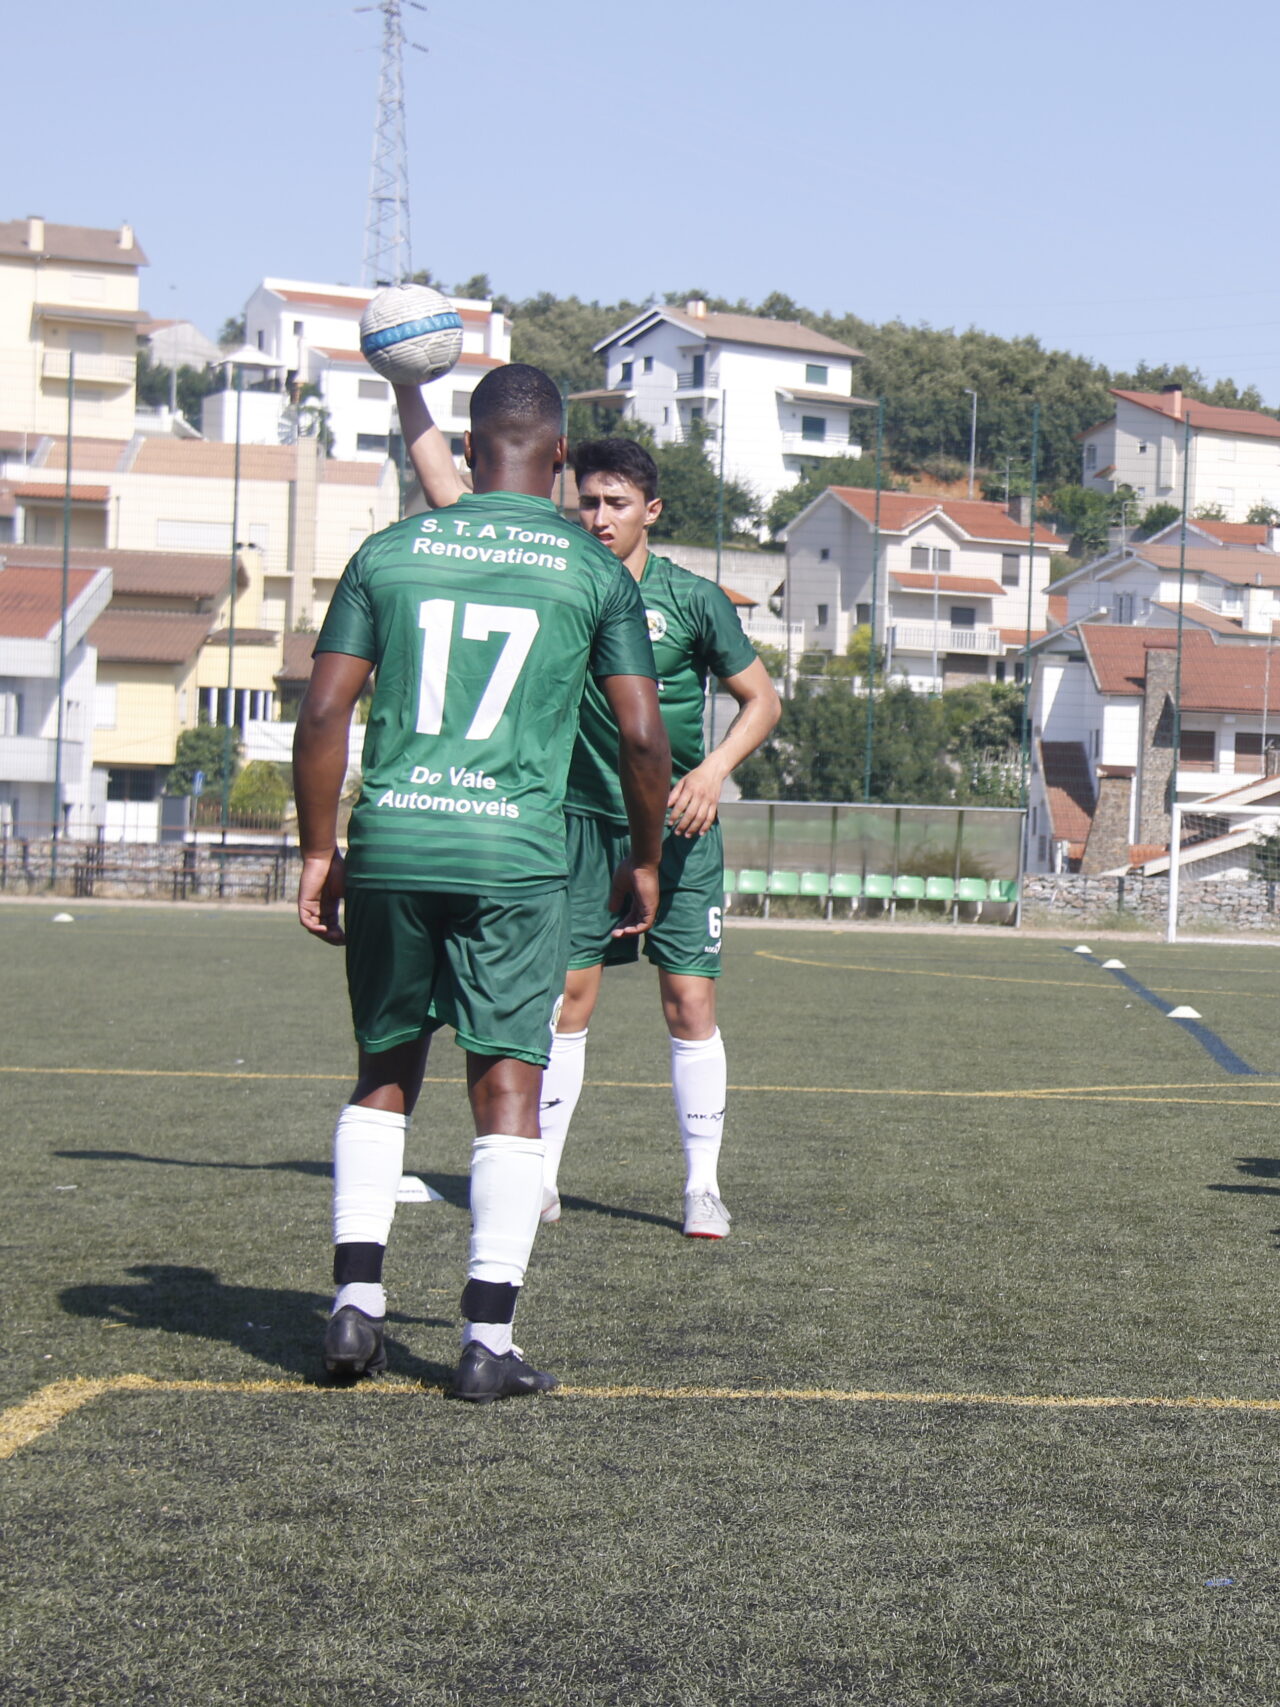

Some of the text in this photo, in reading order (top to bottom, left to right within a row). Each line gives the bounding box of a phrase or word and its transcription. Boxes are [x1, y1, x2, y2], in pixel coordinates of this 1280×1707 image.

[420, 518, 570, 549] S. T. A Tome
[412, 537, 568, 571] Renovations
[415, 598, 540, 740] 17
[410, 766, 497, 790] Do Vale
[377, 790, 520, 819] Automoveis
[708, 906, 721, 938] 6
